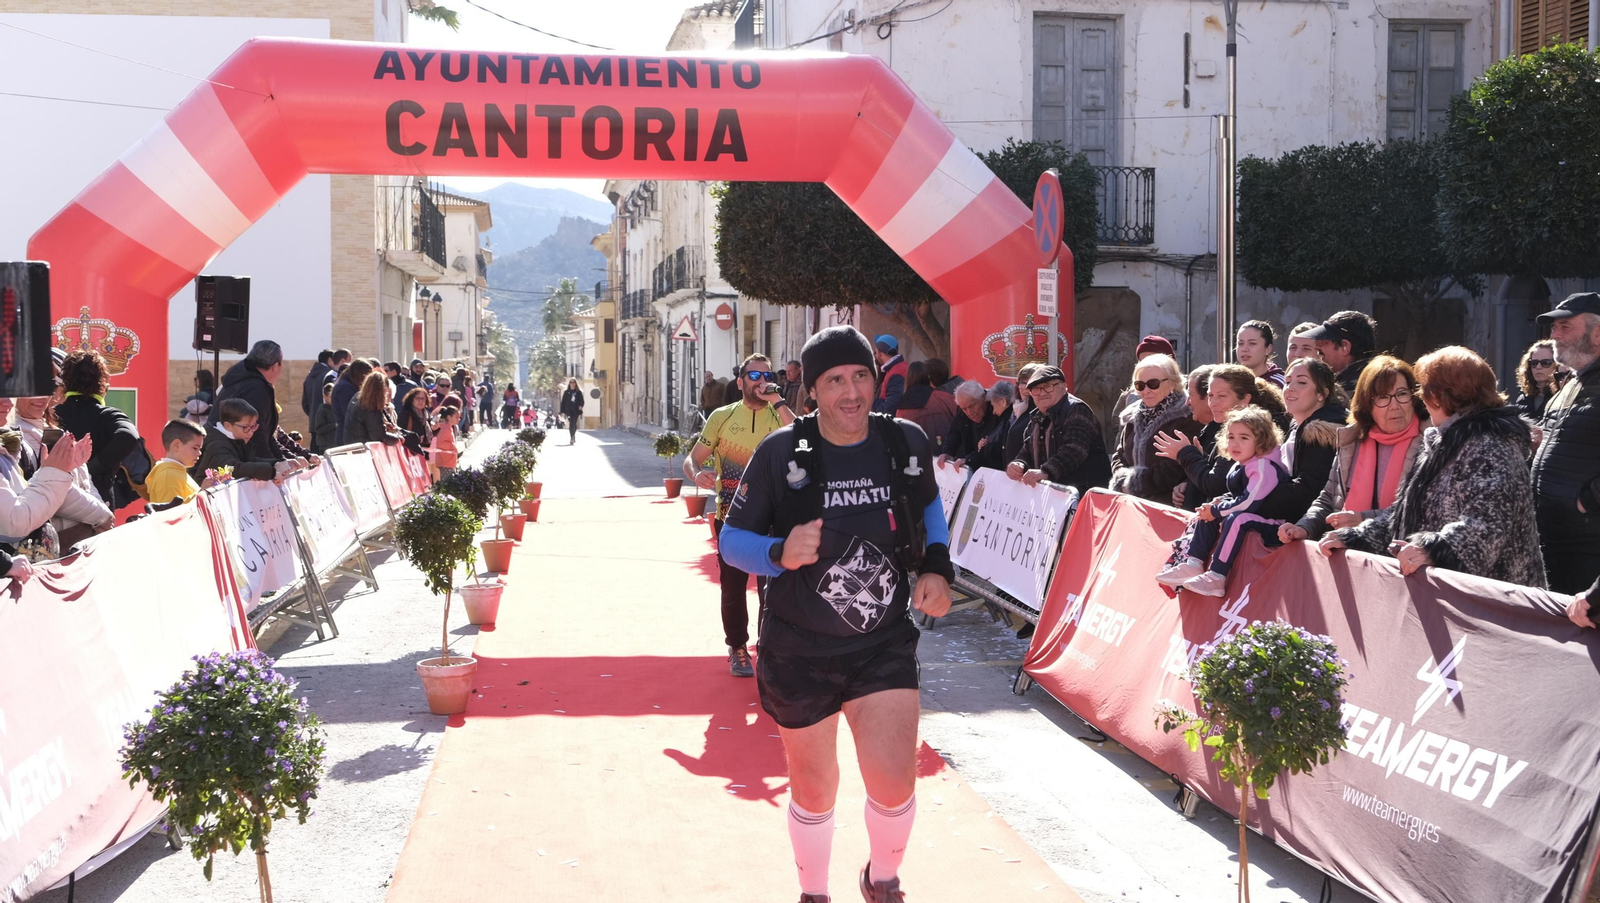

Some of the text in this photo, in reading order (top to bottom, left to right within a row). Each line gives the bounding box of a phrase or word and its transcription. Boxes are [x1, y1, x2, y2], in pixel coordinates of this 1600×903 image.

[373, 50, 762, 90] AYUNTAMIENTO
[385, 99, 749, 162] CANTORIA
[827, 477, 874, 490] MONTAÑA
[984, 498, 1045, 532] AYUNTAMIENTO
[972, 515, 1050, 577] CANTORIA
[1339, 702, 1530, 809] TEAMERGY
[1342, 785, 1442, 843] www.teamergy.es
